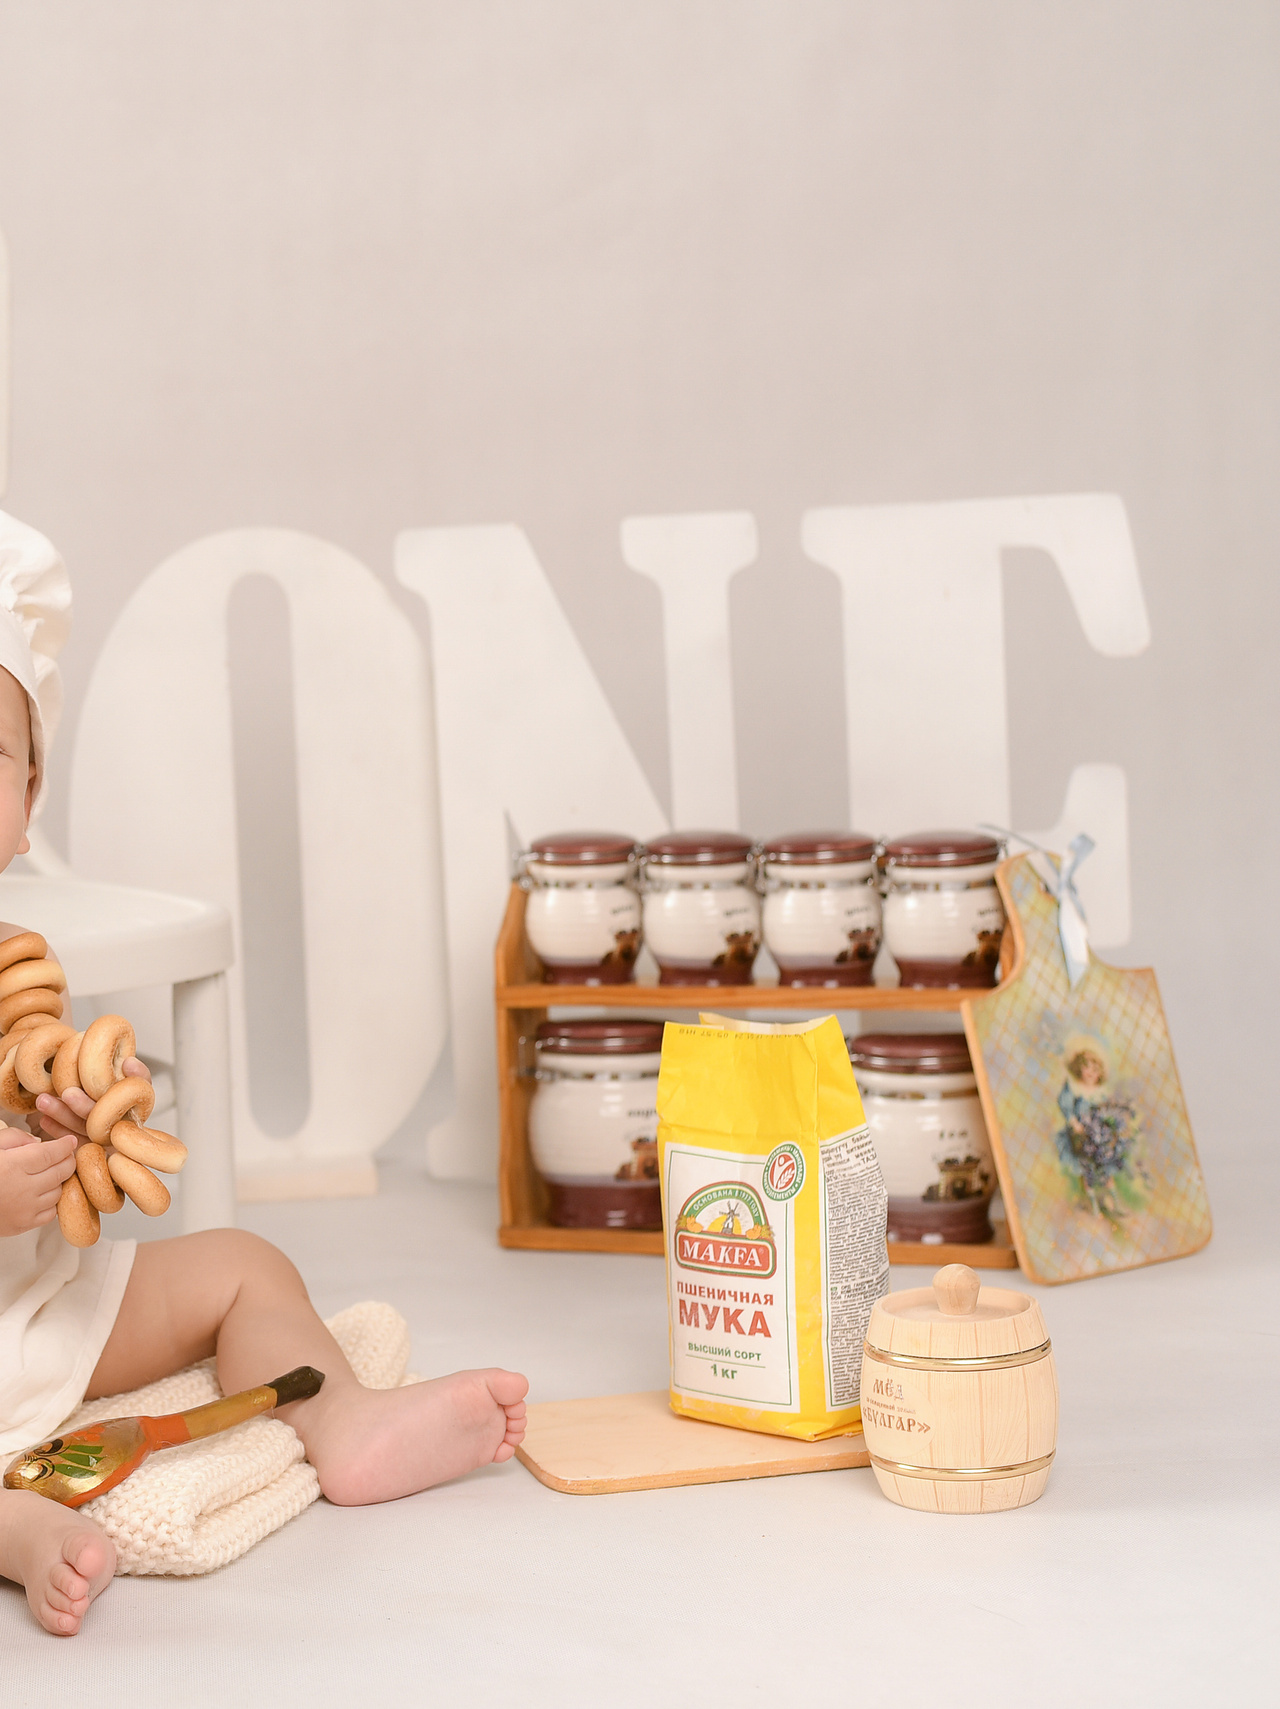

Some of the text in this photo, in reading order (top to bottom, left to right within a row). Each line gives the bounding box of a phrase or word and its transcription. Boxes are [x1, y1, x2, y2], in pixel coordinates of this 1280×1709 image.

[70, 493, 1152, 1180] ONE
[693, 1189, 733, 1211] ОСНОВАНА
[750, 1200, 760, 1217] ГОДУ
[683, 1240, 762, 1267] MAKFA
[677, 1281, 774, 1306] ПШЕНИЧНАЯ
[679, 1299, 772, 1338] МУКА
[688, 1342, 762, 1361] ВЫСШИЙ СОРТ
[710, 1363, 718, 1377] 1
[862, 1406, 931, 1434] «БУЛГАР»
